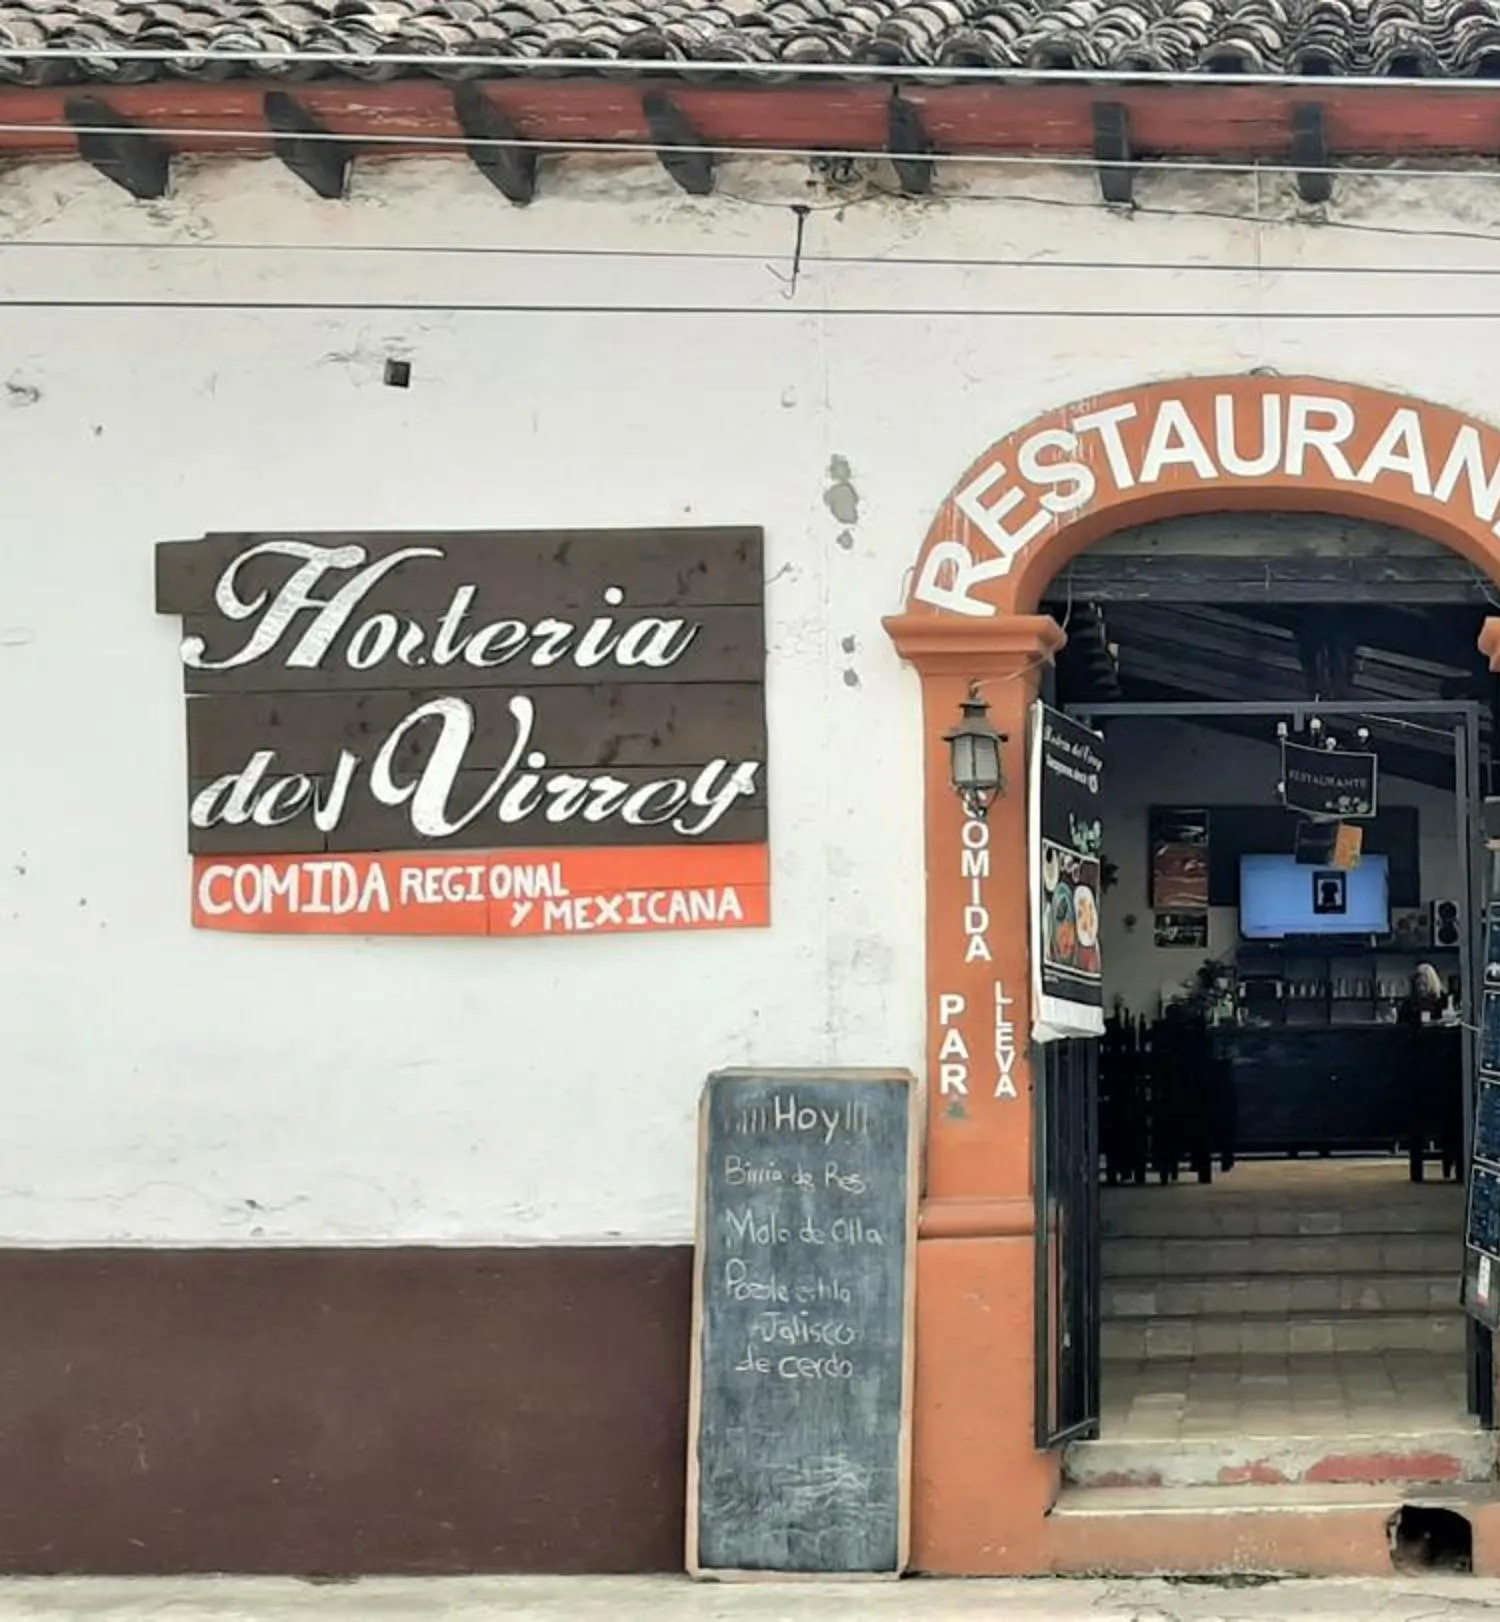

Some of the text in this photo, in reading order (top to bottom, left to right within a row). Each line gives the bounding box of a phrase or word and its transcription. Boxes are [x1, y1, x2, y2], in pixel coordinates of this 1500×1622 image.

[190, 695, 761, 838] del Virrey
[198, 861, 570, 915] COMIDA REGIONAL
[543, 887, 744, 931] MEXICANA
[994, 981, 1017, 1098] LLEVA
[831, 1216, 884, 1246] Olla
[758, 1310, 855, 1346] Jalisco
[735, 1342, 853, 1379] de cerdo
